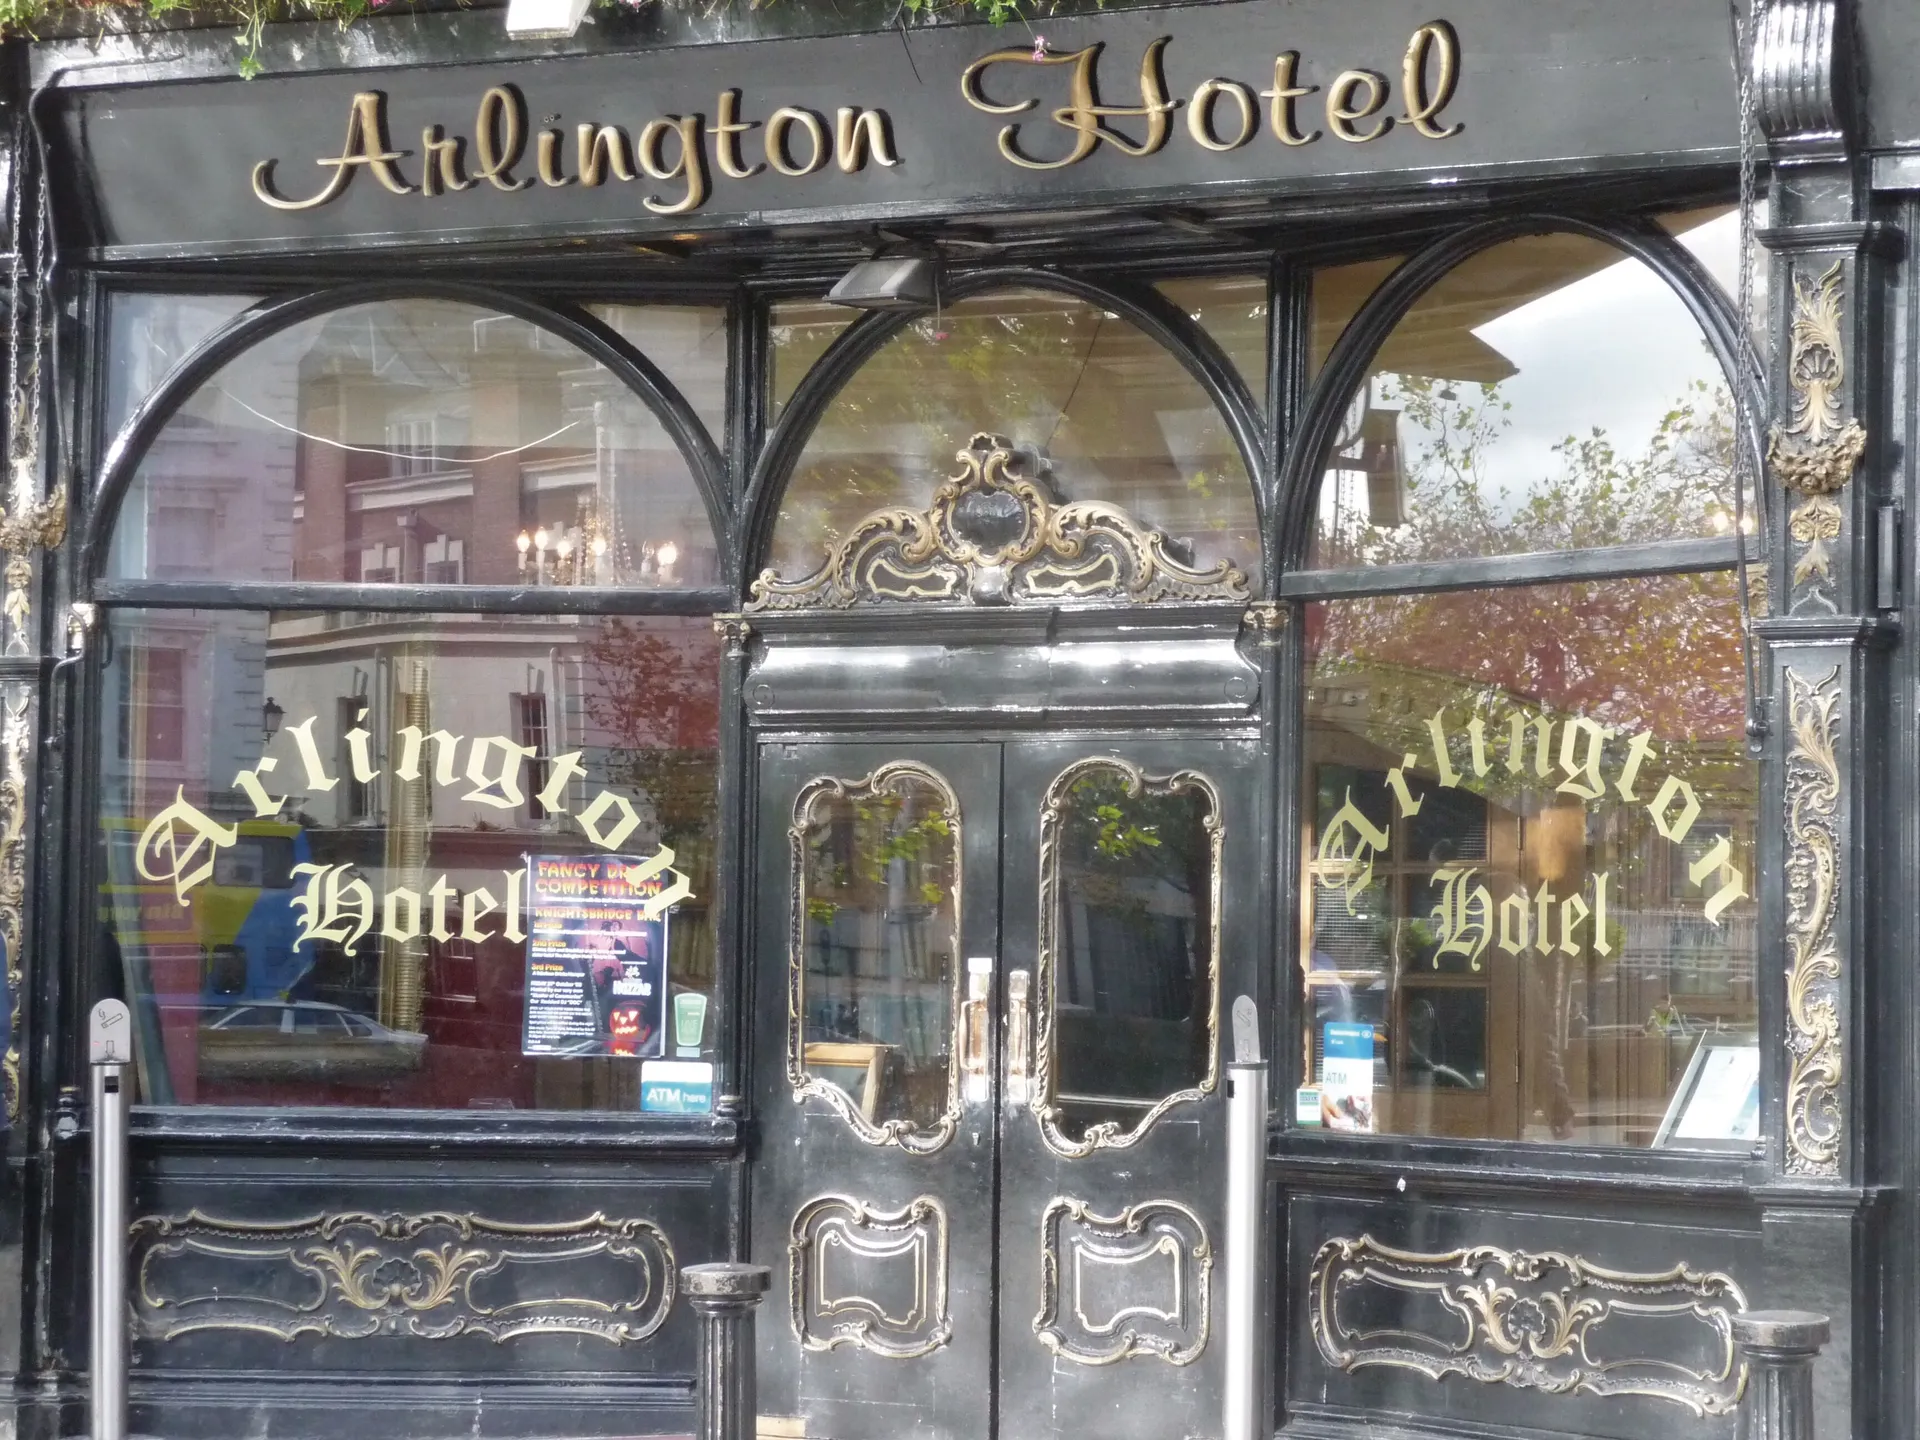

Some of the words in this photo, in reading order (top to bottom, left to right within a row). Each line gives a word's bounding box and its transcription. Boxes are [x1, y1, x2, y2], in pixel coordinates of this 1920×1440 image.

[252, 83, 906, 215] Arlington
[961, 18, 1465, 171] Hotel
[135, 707, 697, 917] Arlington
[1317, 705, 1749, 927] Arlington
[538, 861, 601, 879] FANCY
[535, 878, 663, 898] COMPETITION
[289, 862, 528, 957] Hotel
[535, 906, 633, 920] KNIGHTSBRIDGE
[1430, 867, 1612, 972] Hotel
[548, 940, 567, 948] Prize
[531, 963, 544, 971] 3rd
[545, 963, 564, 972] Prize
[1325, 1071, 1347, 1085] ATM
[646, 1087, 681, 1102] ATM
